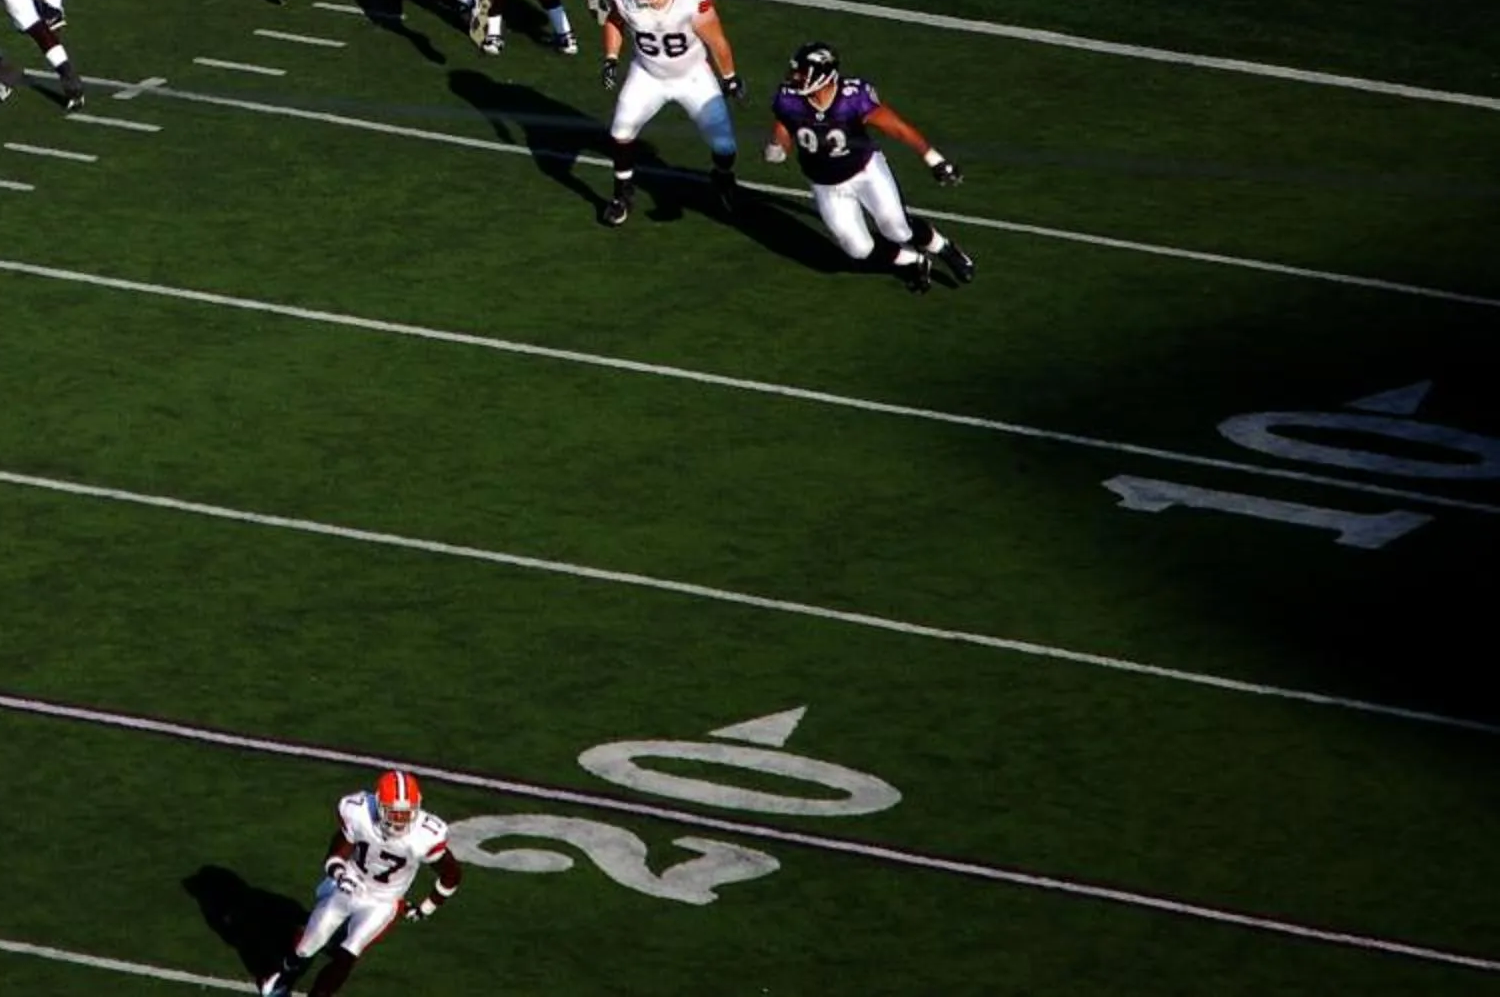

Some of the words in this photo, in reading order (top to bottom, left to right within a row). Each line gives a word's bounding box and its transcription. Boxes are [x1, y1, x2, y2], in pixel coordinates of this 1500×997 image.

[635, 31, 688, 58] 68
[797, 126, 850, 158] 92
[444, 739, 902, 905] 20
[355, 840, 407, 884] 17
